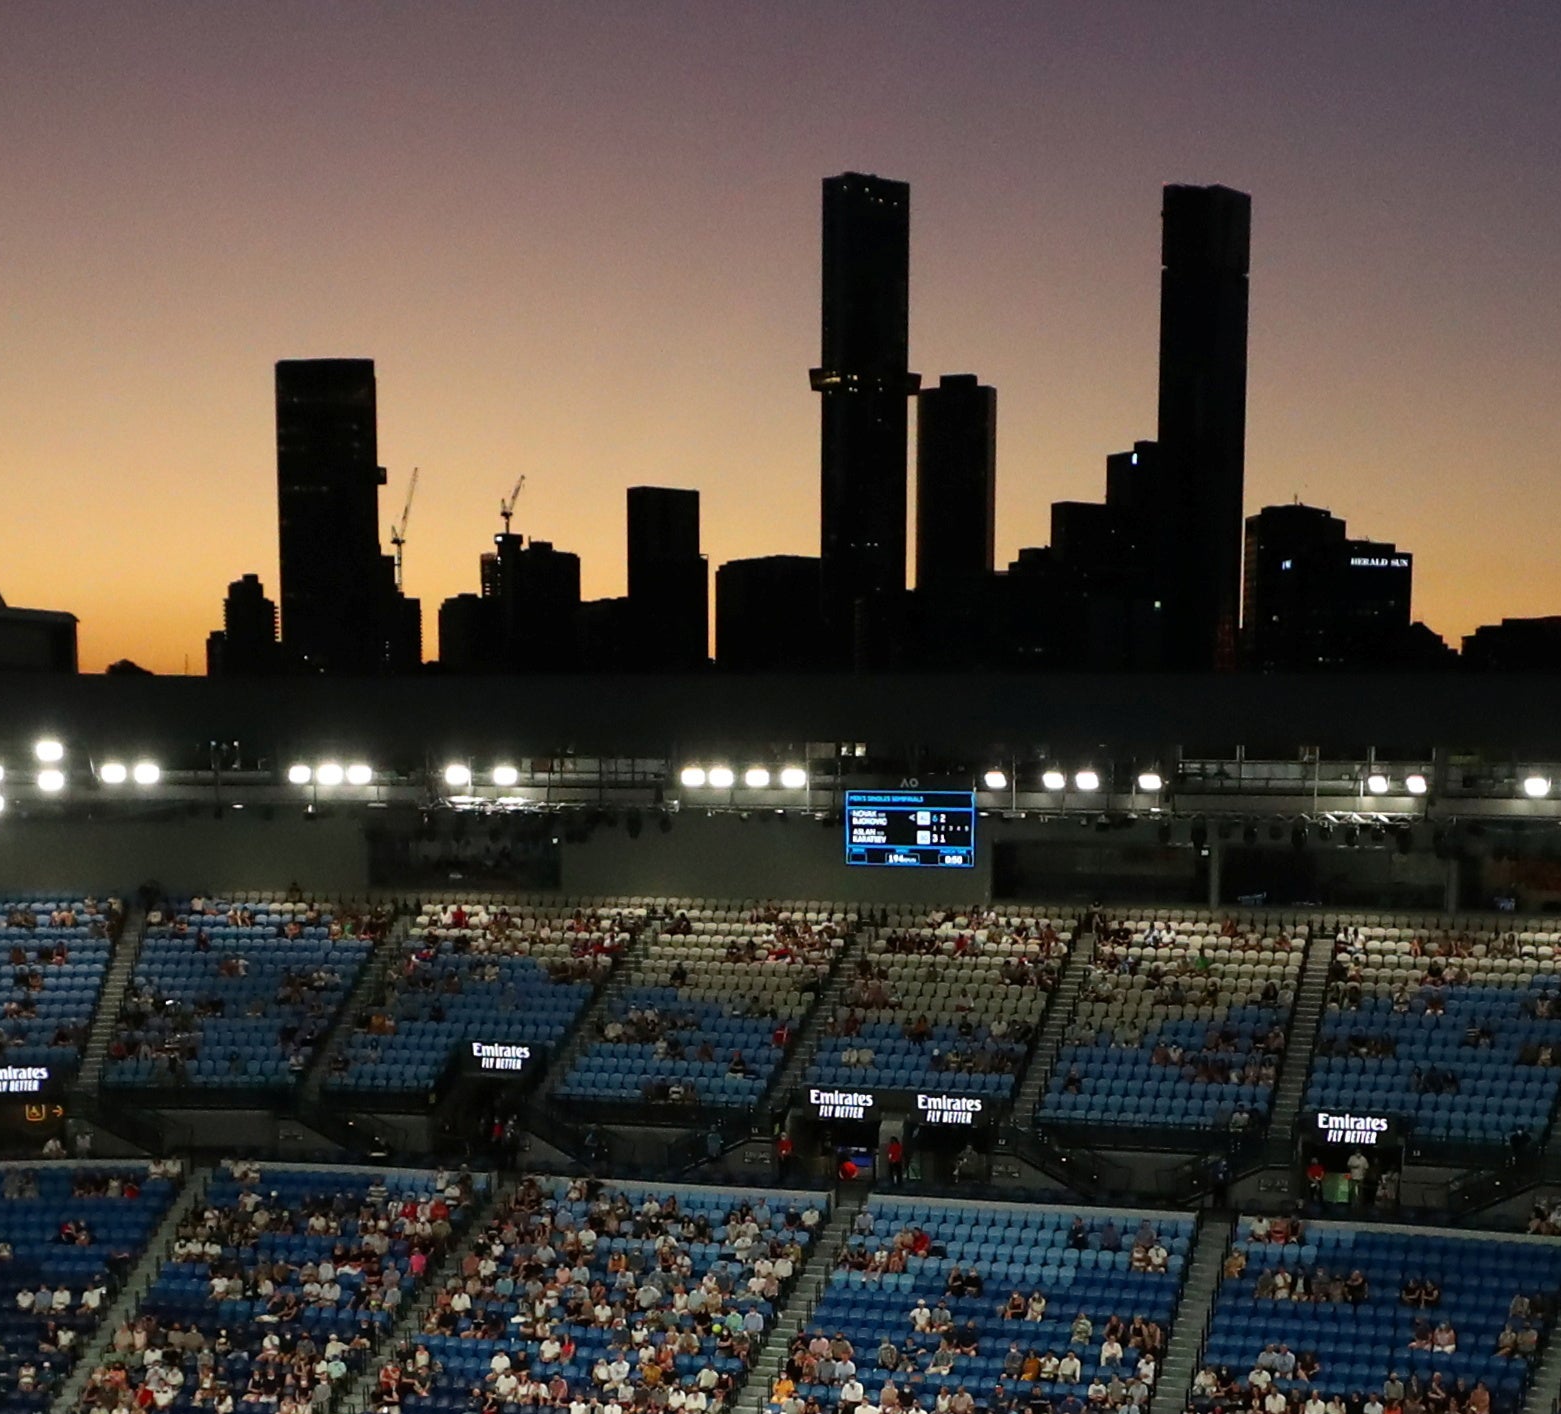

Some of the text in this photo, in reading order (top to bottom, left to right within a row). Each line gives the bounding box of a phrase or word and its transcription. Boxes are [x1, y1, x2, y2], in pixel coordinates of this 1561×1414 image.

[1351, 557, 1409, 567] HERALD SUN
[940, 814, 946, 823] 2
[932, 834, 938, 843] 3
[940, 834, 946, 843] 1
[472, 1042, 531, 1058] Emirates
[810, 1089, 874, 1107] Emirates
[917, 1094, 982, 1111] Emirates
[1318, 1112, 1388, 1131] Emirates
